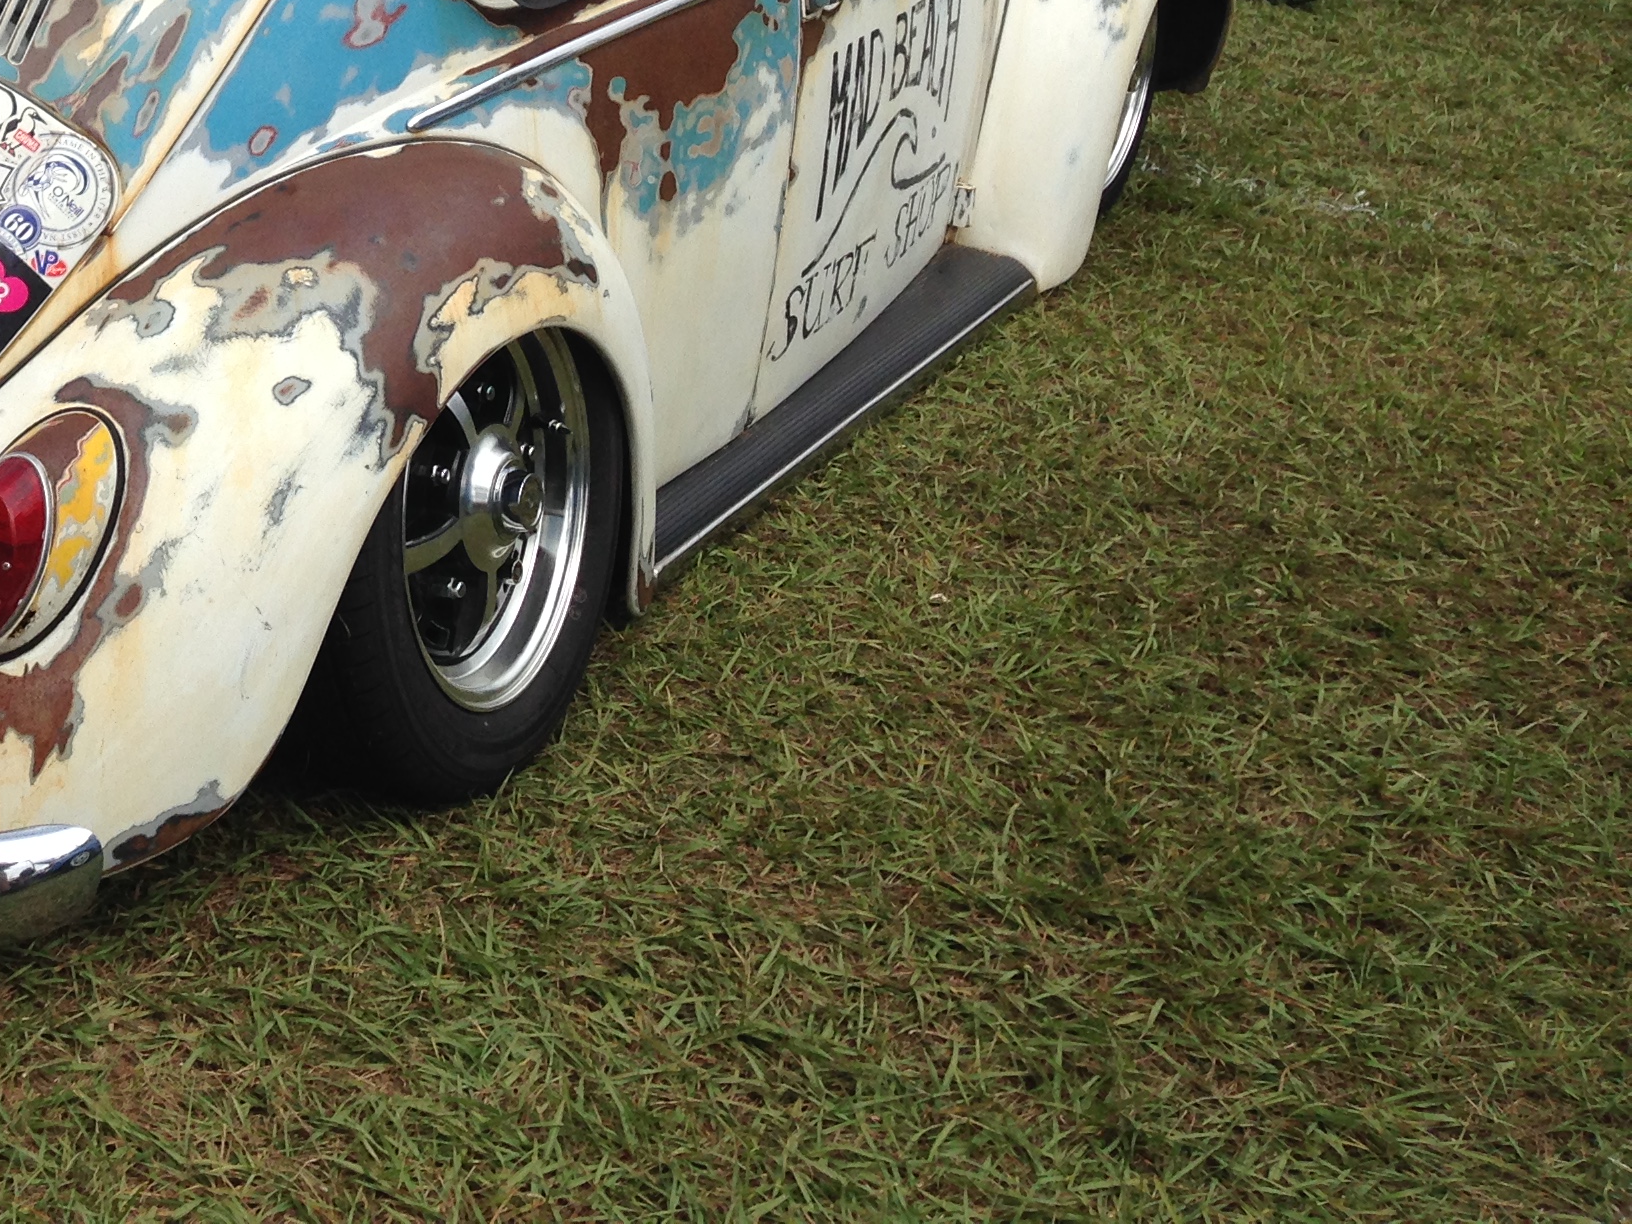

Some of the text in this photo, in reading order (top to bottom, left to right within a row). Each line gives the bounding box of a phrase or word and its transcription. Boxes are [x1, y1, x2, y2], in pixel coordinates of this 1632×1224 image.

[815, 28, 886, 223] MAD
[52, 185, 85, 218] O'Neill
[3, 212, 34, 241] 60
[34, 248, 59, 276] VP
[766, 162, 959, 362] SURF SHOP
